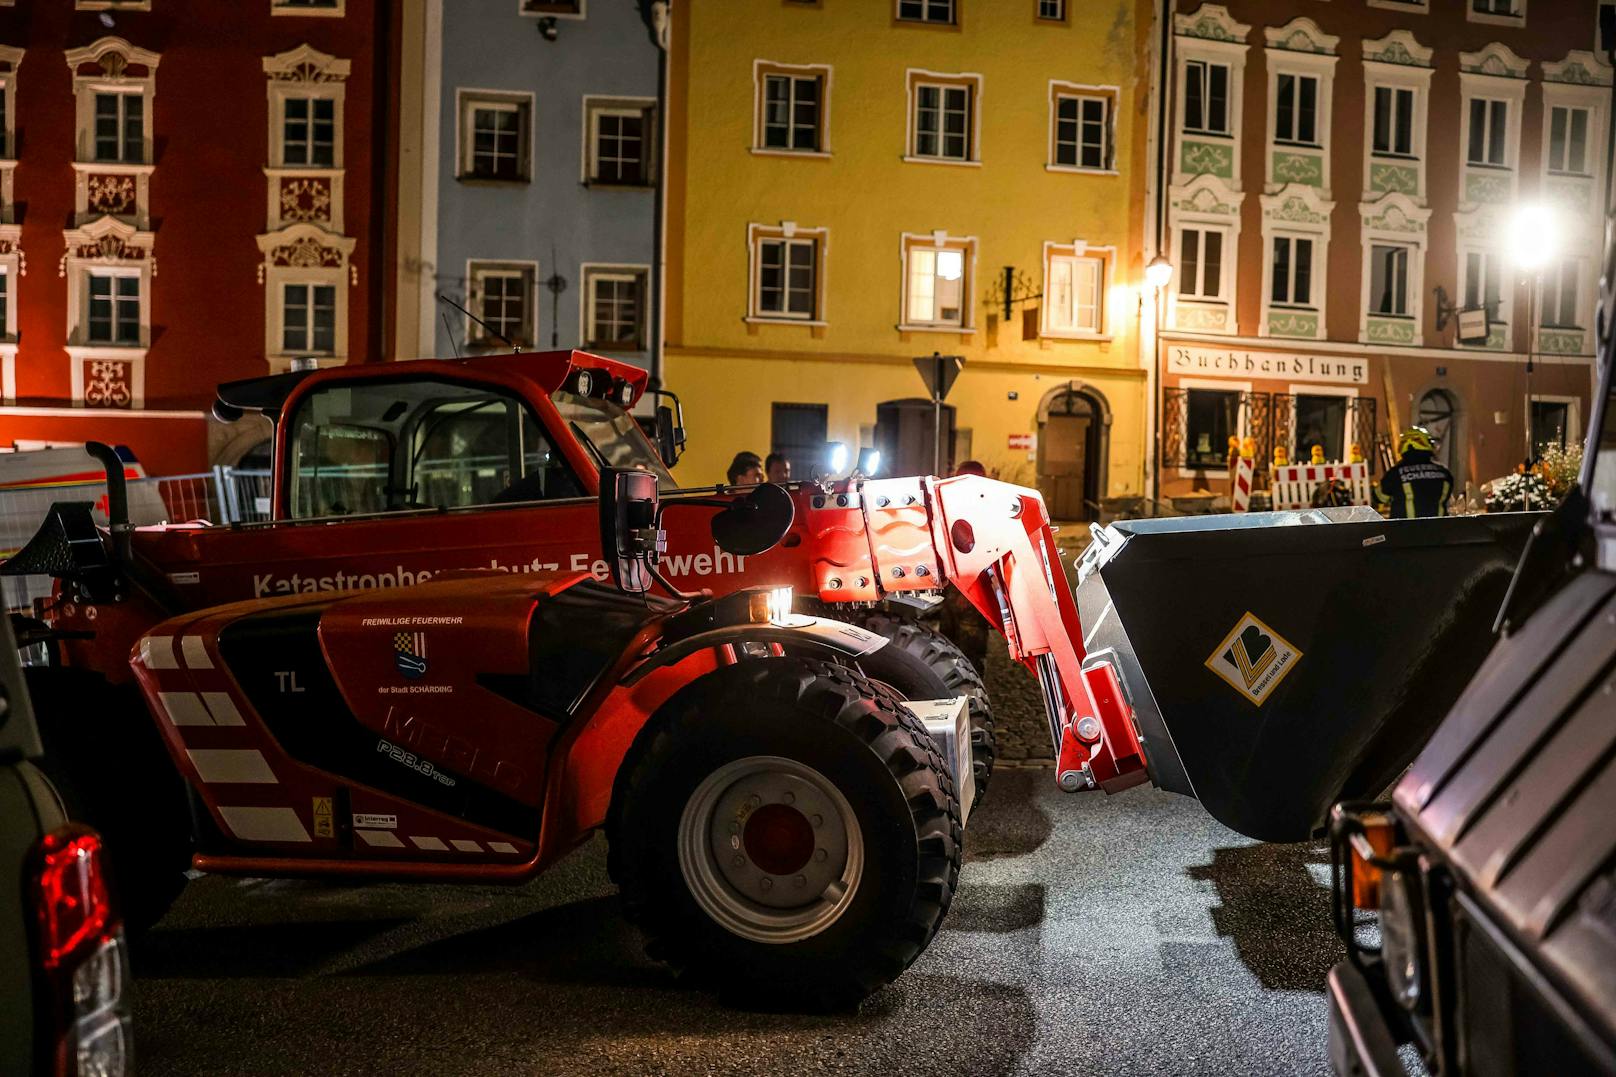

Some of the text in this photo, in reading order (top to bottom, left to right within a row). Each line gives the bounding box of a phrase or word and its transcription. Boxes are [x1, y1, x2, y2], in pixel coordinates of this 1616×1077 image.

[1175, 349, 1363, 381] Buchhandlung
[253, 545, 750, 598] Katastrophet Ferwehr
[361, 616, 463, 626] FREIWILLIGE FEUERWEHR
[1269, 663, 1280, 676] und
[273, 671, 306, 693] TL
[378, 684, 454, 694] der Stadt SCHÄRDING
